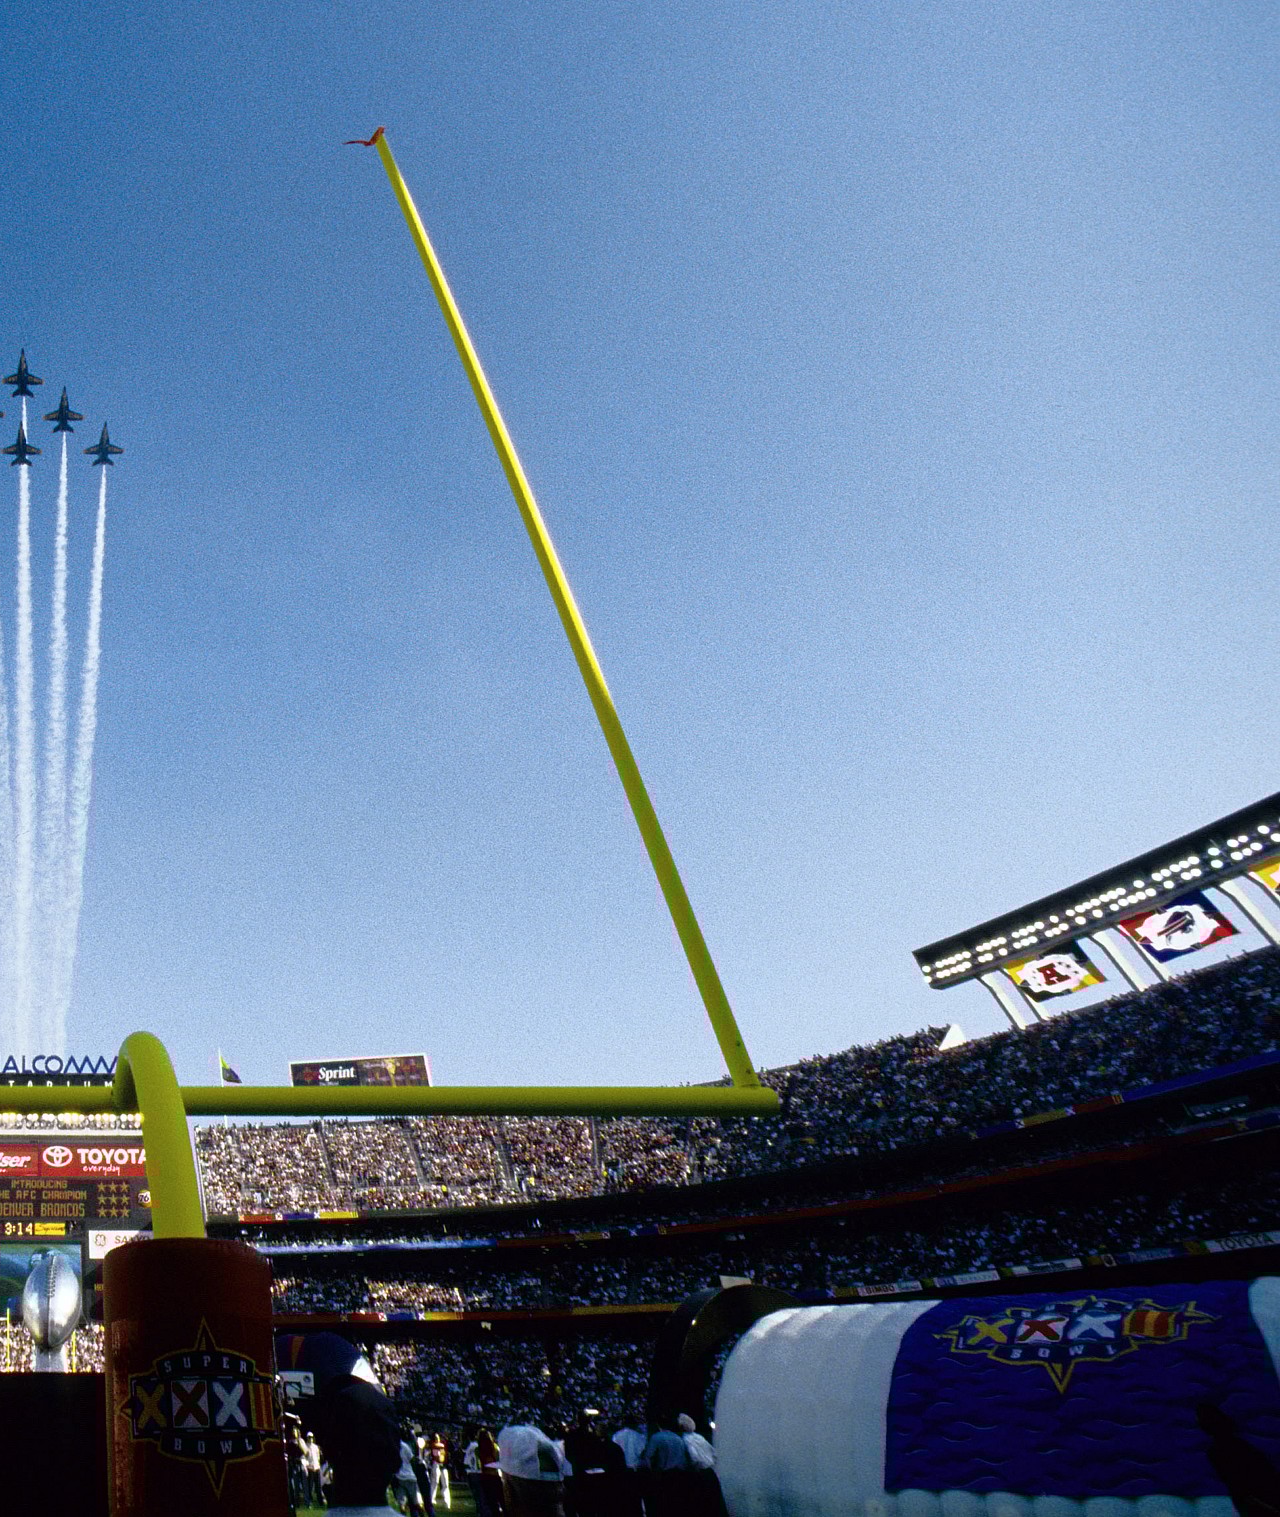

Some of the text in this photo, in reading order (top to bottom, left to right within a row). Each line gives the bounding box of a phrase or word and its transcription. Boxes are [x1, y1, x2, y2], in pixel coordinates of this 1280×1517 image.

[318, 1066, 356, 1082] Sprint
[77, 1148, 147, 1165] TOYOTA
[82, 1164, 121, 1176] everyday
[11, 1179, 68, 1189] INTRODUCING
[15, 1190, 36, 1199] AFC
[42, 1190, 87, 1199] CHAMPION
[138, 1192, 150, 1203] 76
[40, 1202, 86, 1217] BRONCOS
[4, 1222, 33, 1236] 3:14
[164, 1355, 247, 1373] SUPER
[173, 1438, 253, 1454] BOWL
